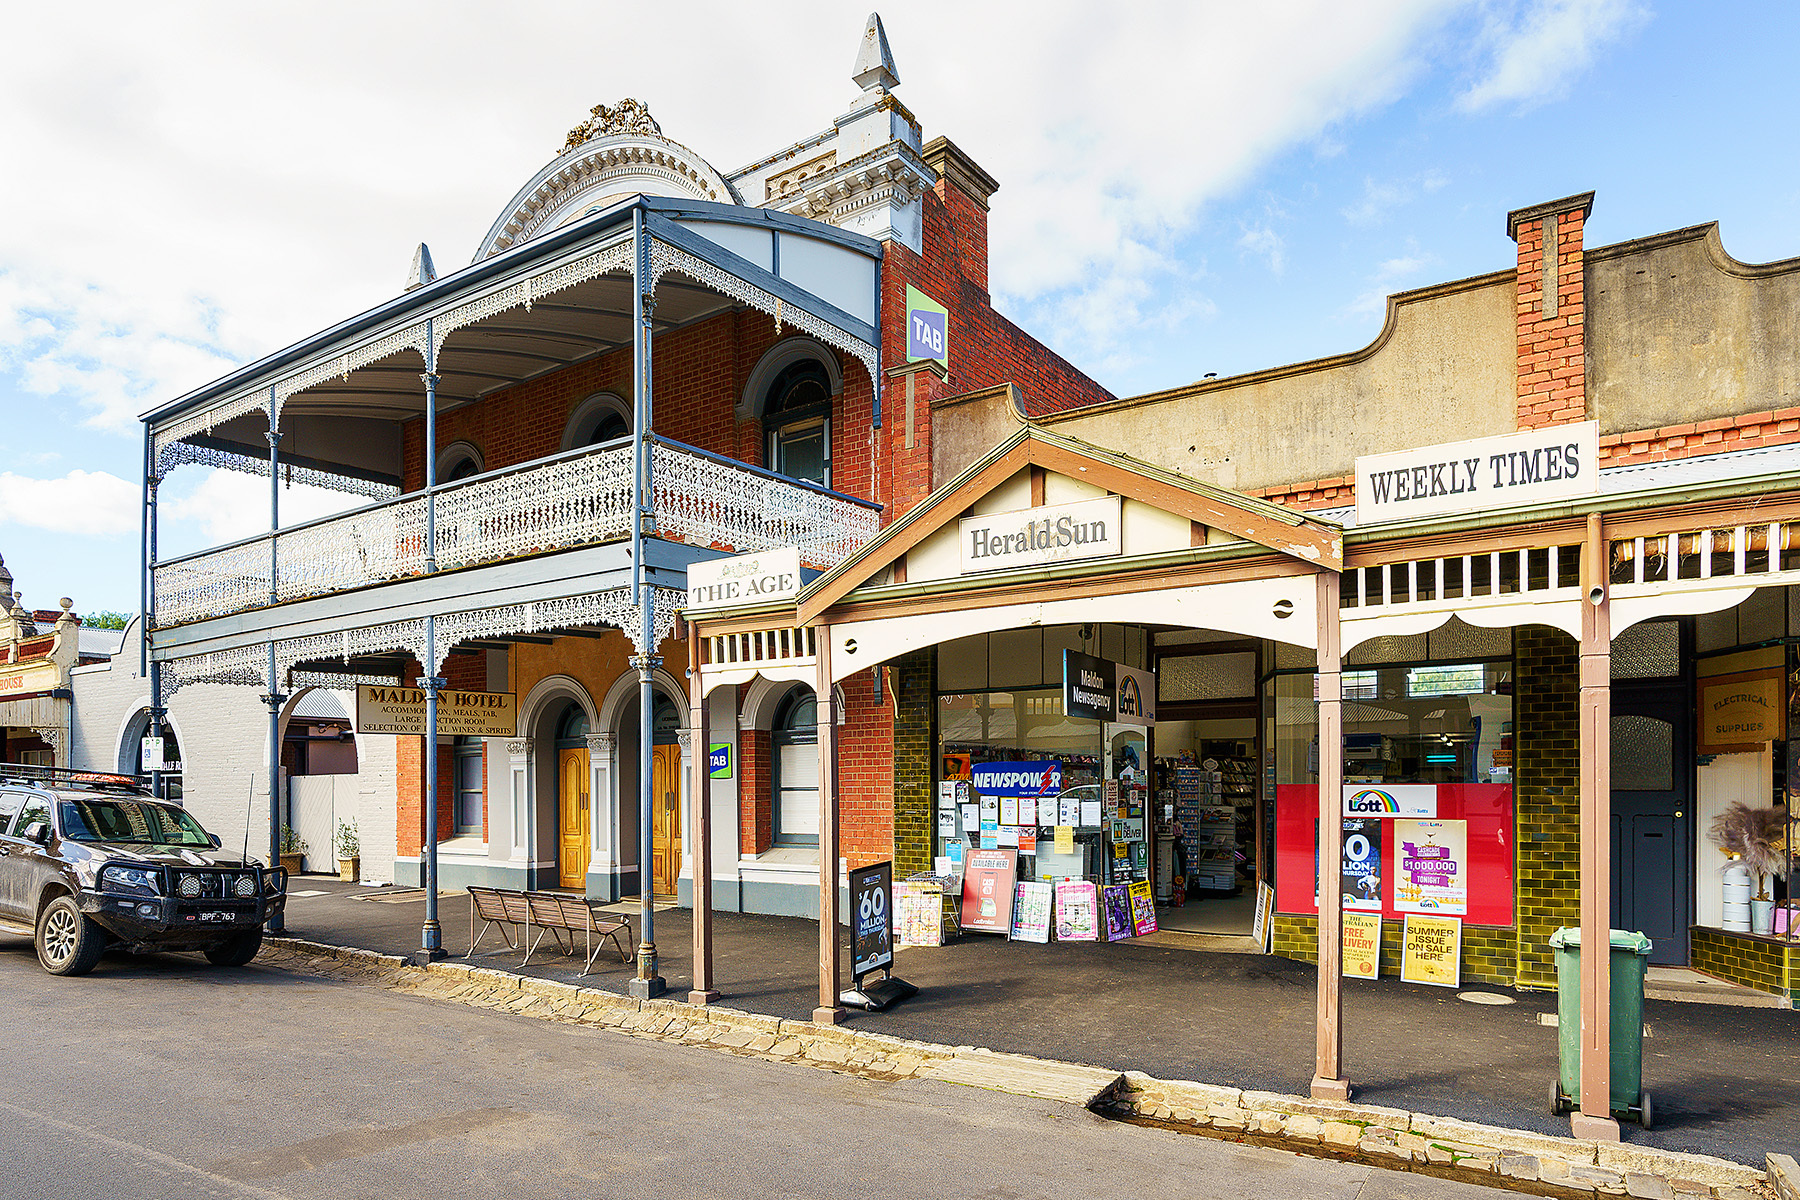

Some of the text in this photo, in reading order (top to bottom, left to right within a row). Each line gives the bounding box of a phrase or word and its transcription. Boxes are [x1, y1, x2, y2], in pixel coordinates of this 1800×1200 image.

[913, 315, 942, 354] TAB
[1369, 443, 1580, 505] WEEKLY TIMES
[693, 573, 794, 604] THE AGE
[1081, 669, 1104, 690] Maldon
[368, 688, 508, 709] MALDN HOTEL
[1073, 686, 1111, 712] Newsagency
[1713, 694, 1769, 711] ELECTRICAL
[381, 706, 450, 715] ACCOMMODON,
[453, 709, 480, 717] MEALS,
[395, 716, 421, 724] LARGE
[363, 723, 408, 732] SELECTION
[485, 727, 512, 735] SPIRITS
[1715, 722, 1764, 734] SUPPLIES
[710, 755, 727, 767] TAB
[946, 773, 970, 781] ATM
[1348, 799, 1382, 813] Lott
[1404, 860, 1455, 872] $1,000,000
[1416, 875, 1441, 885] TONIGHT
[860, 914, 885, 931] MILLION
[1343, 920, 1373, 928] TRALIAN
[1344, 927, 1365, 938] FREE
[1407, 926, 1454, 937] SUMMER
[1343, 938, 1373, 949] LIVERY
[1415, 935, 1445, 945] ISSUE
[1407, 943, 1452, 954] ON SALE
[1415, 952, 1443, 962] HERE
